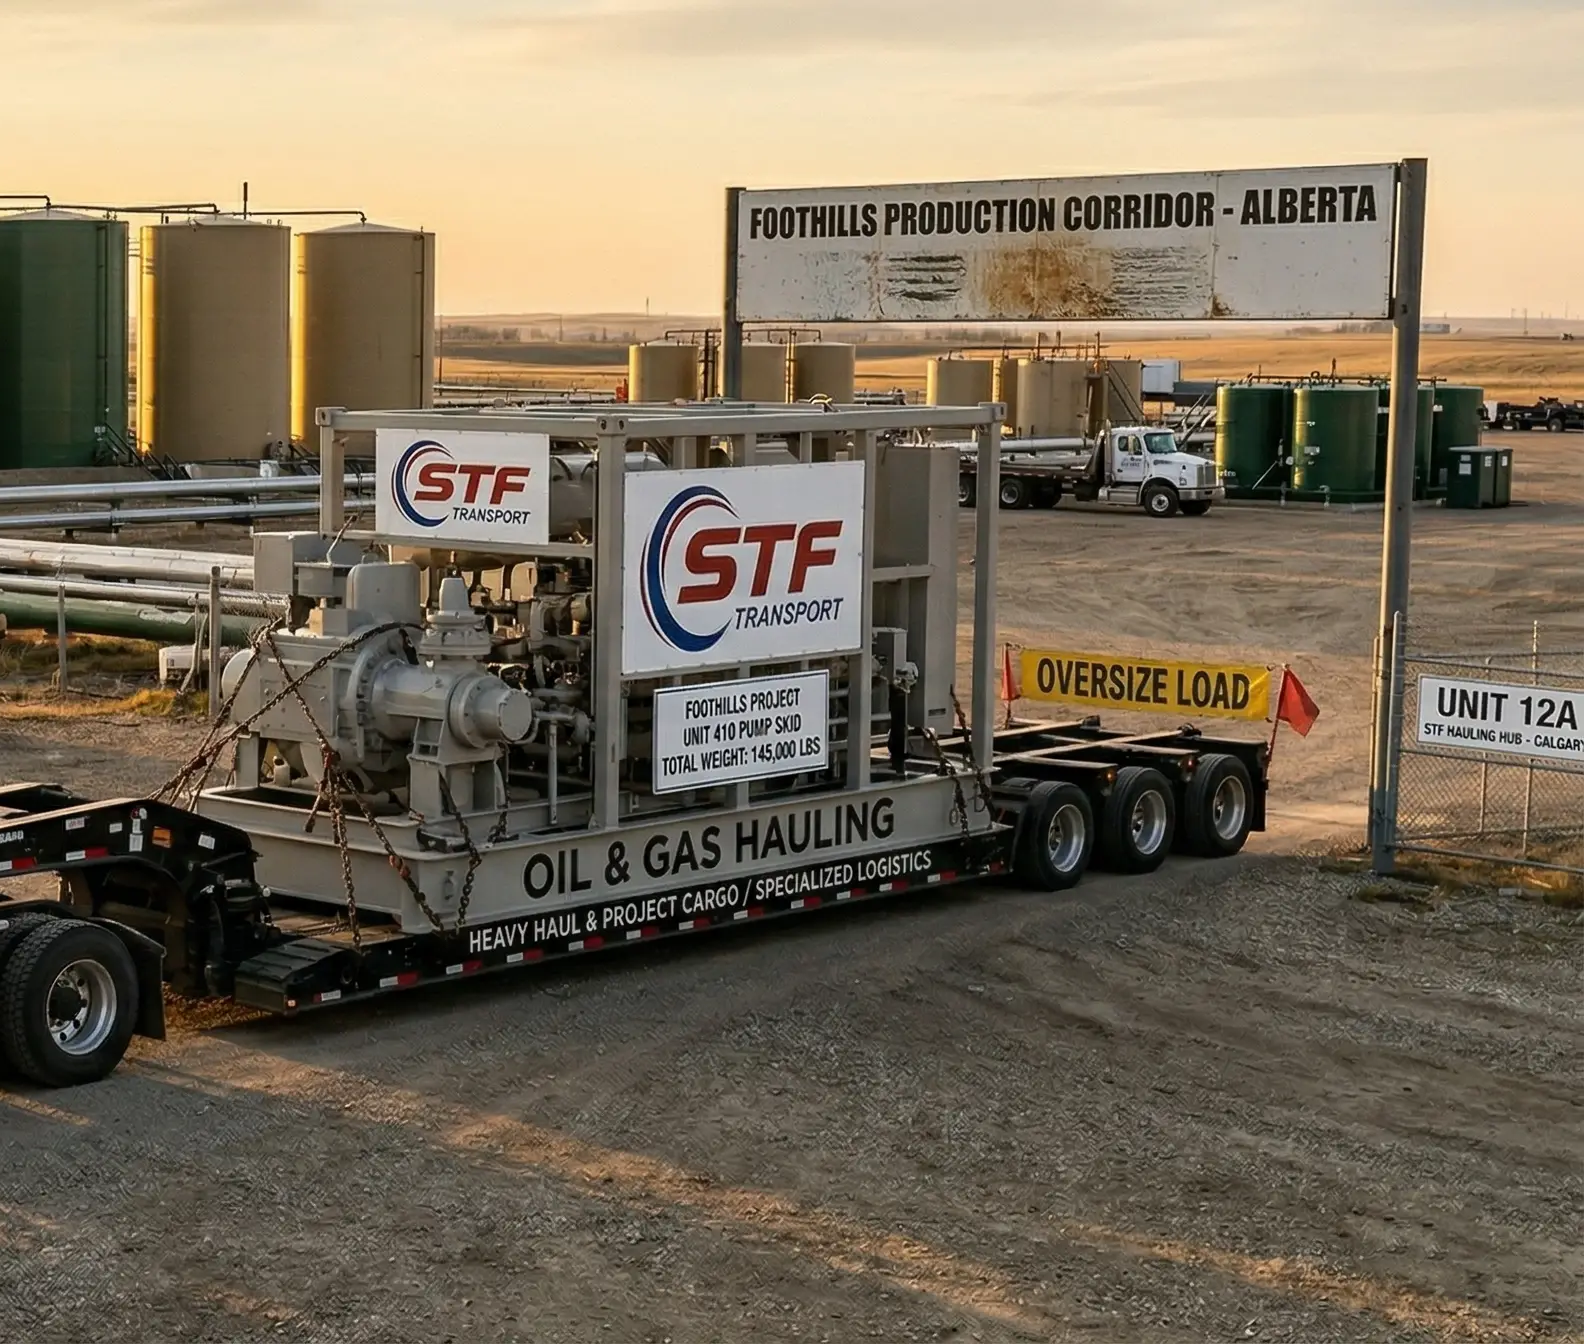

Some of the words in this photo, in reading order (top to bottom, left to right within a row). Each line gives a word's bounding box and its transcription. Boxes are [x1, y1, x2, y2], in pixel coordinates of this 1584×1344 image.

[749, 203, 877, 240] FOOTHILLS
[884, 197, 1056, 236] PRODUCTION
[1064, 191, 1214, 231] CORRIDOR
[1240, 184, 1377, 225] ALBERTA
[413, 462, 531, 505] STF
[452, 507, 531, 525] TRANSPORT
[677, 520, 843, 605] STF
[735, 597, 843, 630] TRANSPORT
[685, 694, 747, 719] FOOTHILLS
[750, 688, 801, 711] PROJECT
[1037, 658, 1168, 704] OVERSIZE
[1176, 669, 1250, 710] LOAD
[683, 725, 711, 747] UNIT
[713, 721, 736, 742] 410
[739, 716, 772, 739] PUMP
[775, 713, 802, 734] SKID
[1437, 687, 1509, 722] UNIT
[1519, 696, 1578, 730] 12A
[1424, 722, 1444, 737] STF
[1447, 724, 1496, 742] HAULING
[1499, 732, 1522, 745] HUB
[662, 753, 698, 776] TOTAL
[701, 746, 748, 771] WEIGHT:
[751, 740, 796, 764] 145,000
[799, 736, 821, 757] LBS
[523, 848, 592, 899] OIL
[604, 841, 631, 886] &
[643, 826, 721, 878] GAS
[736, 797, 895, 863] HAULING
[469, 921, 529, 953] HEAVY
[534, 913, 581, 942] HAUL
[586, 909, 597, 932] &
[602, 895, 678, 929] PROJECT
[681, 884, 739, 915] CARGO
[742, 879, 752, 907] /
[755, 863, 854, 901] SPECIALIZED
[857, 849, 932, 881] LOGISTICS
